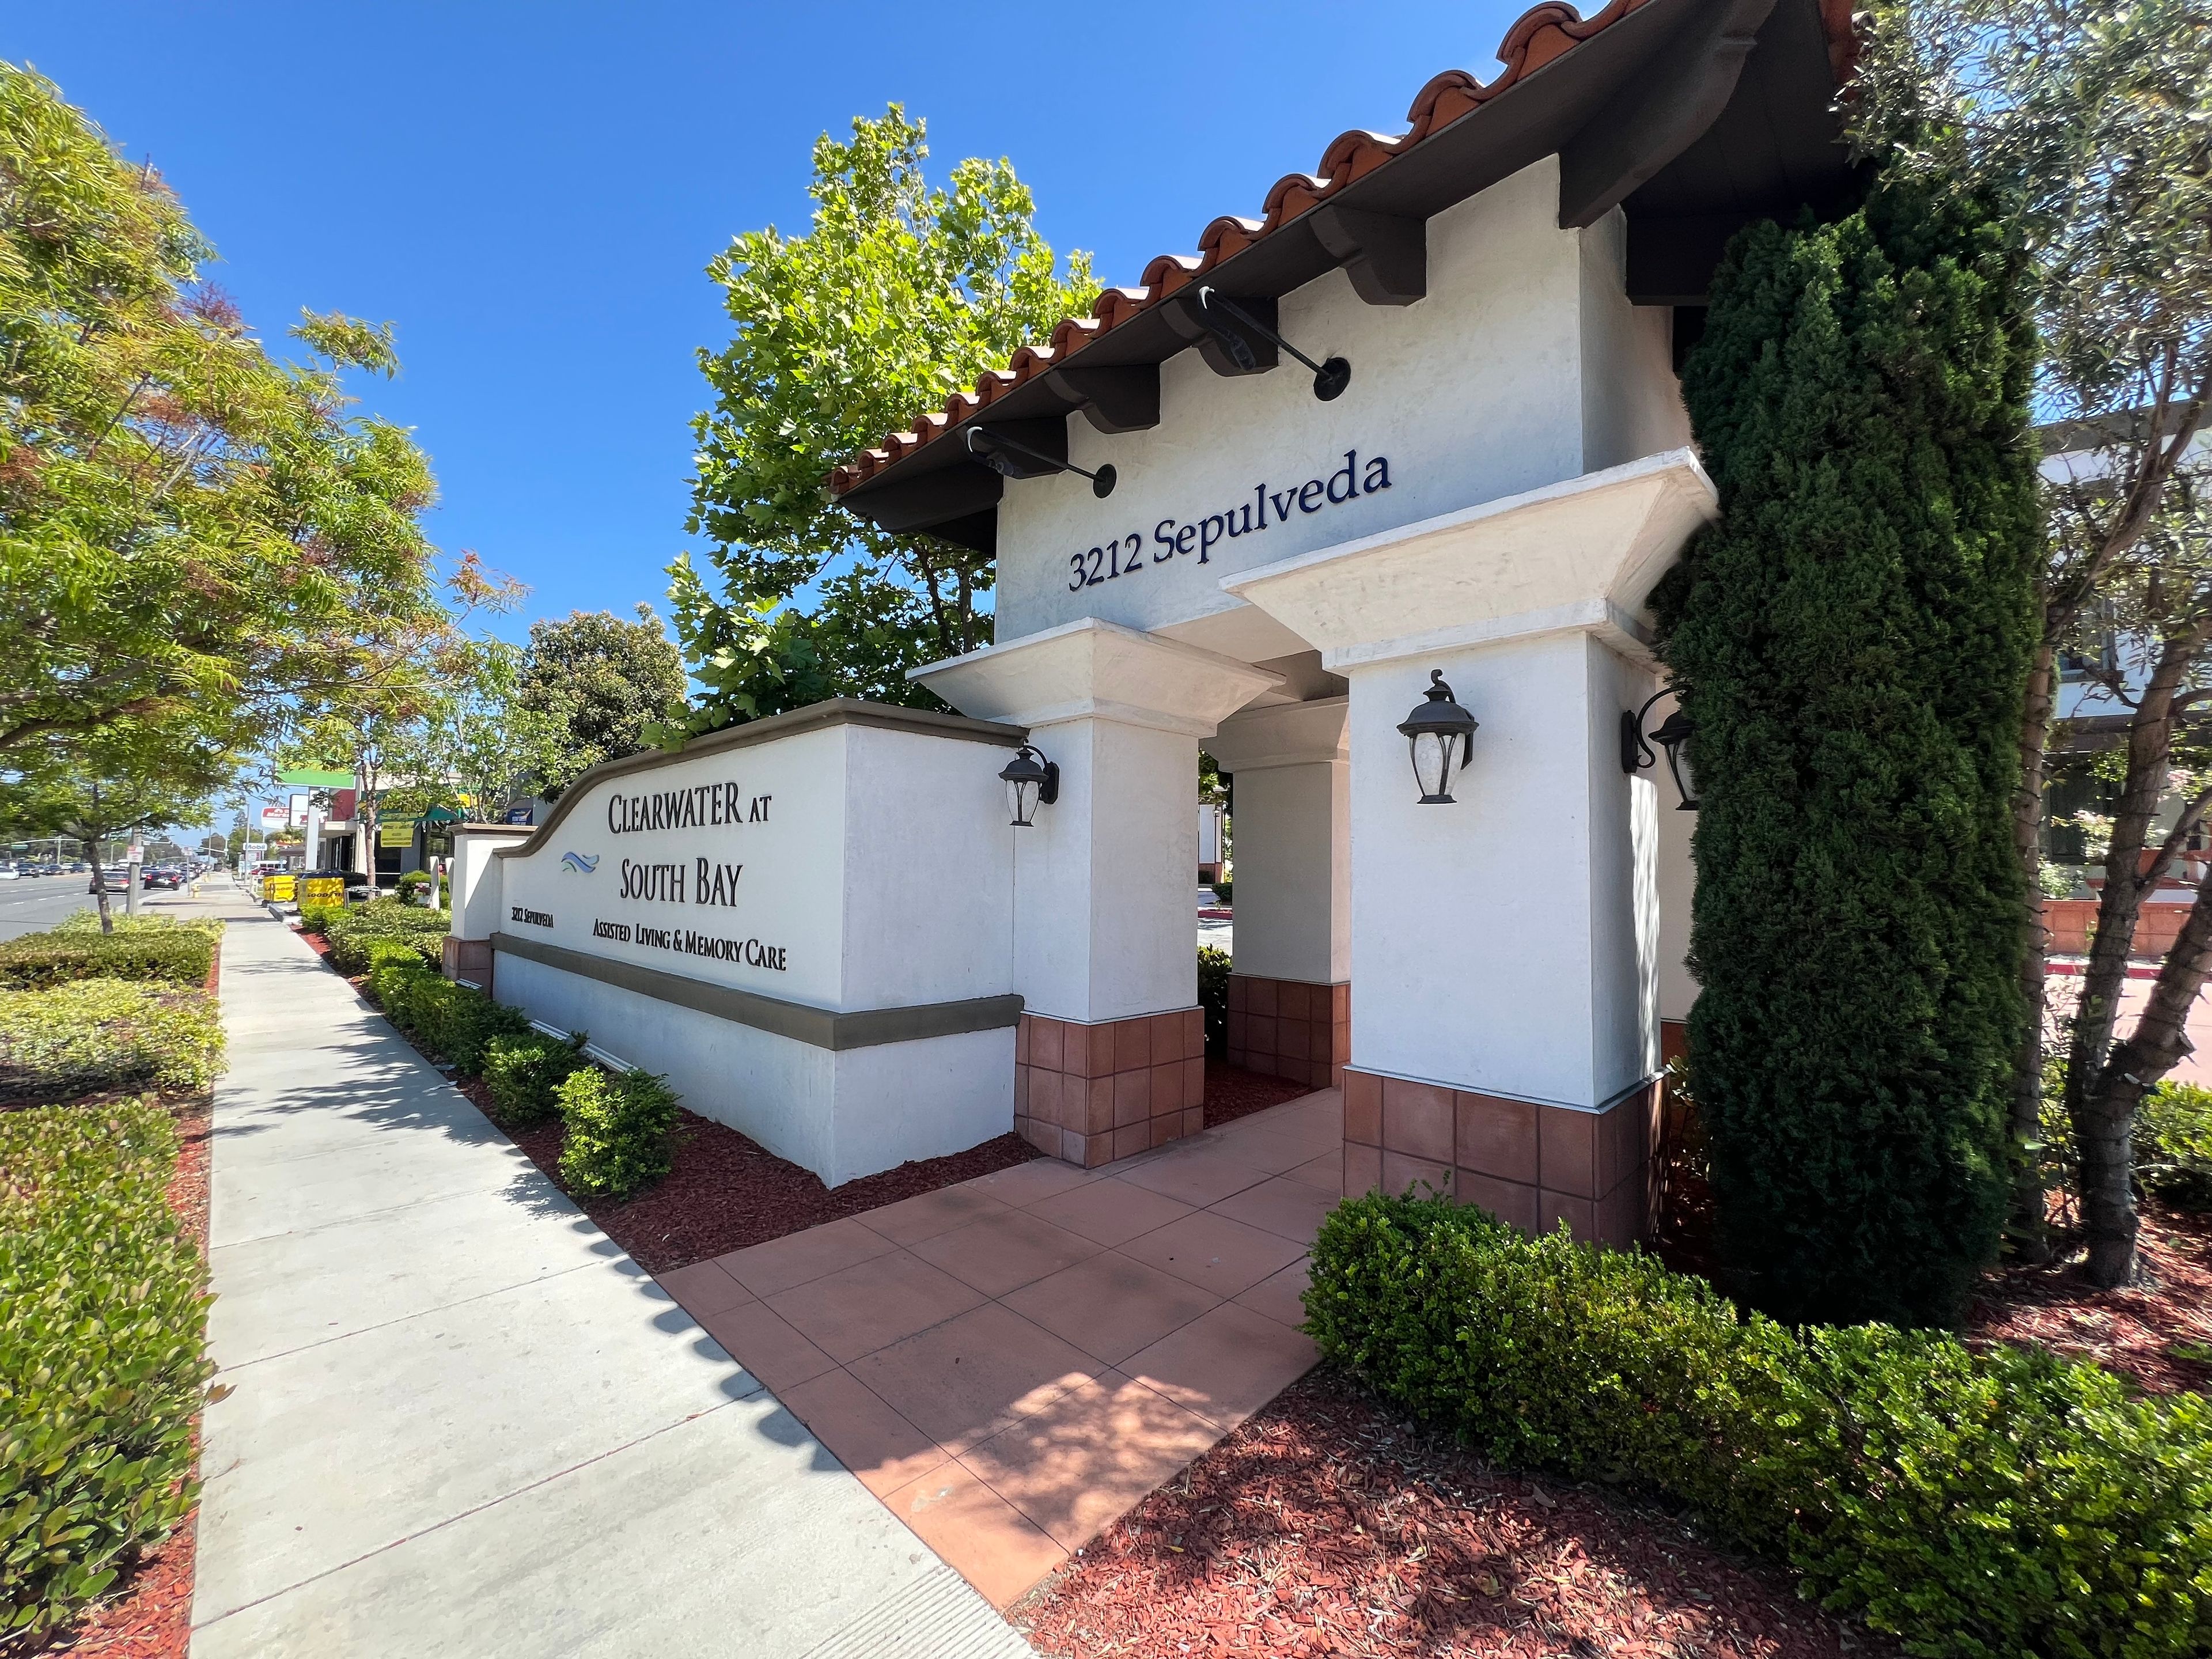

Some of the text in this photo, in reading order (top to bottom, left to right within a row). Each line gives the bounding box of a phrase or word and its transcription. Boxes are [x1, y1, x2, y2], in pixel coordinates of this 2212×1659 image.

[1069, 449, 1392, 592] 3212 Sepulveda
[608, 782, 772, 834] CLEARWATER AT
[620, 857, 743, 907] SOUTH BAY
[524, 908, 554, 929] SEPULVEDA
[593, 918, 787, 971] ASSISTED LIVING & MEMORY CARE
